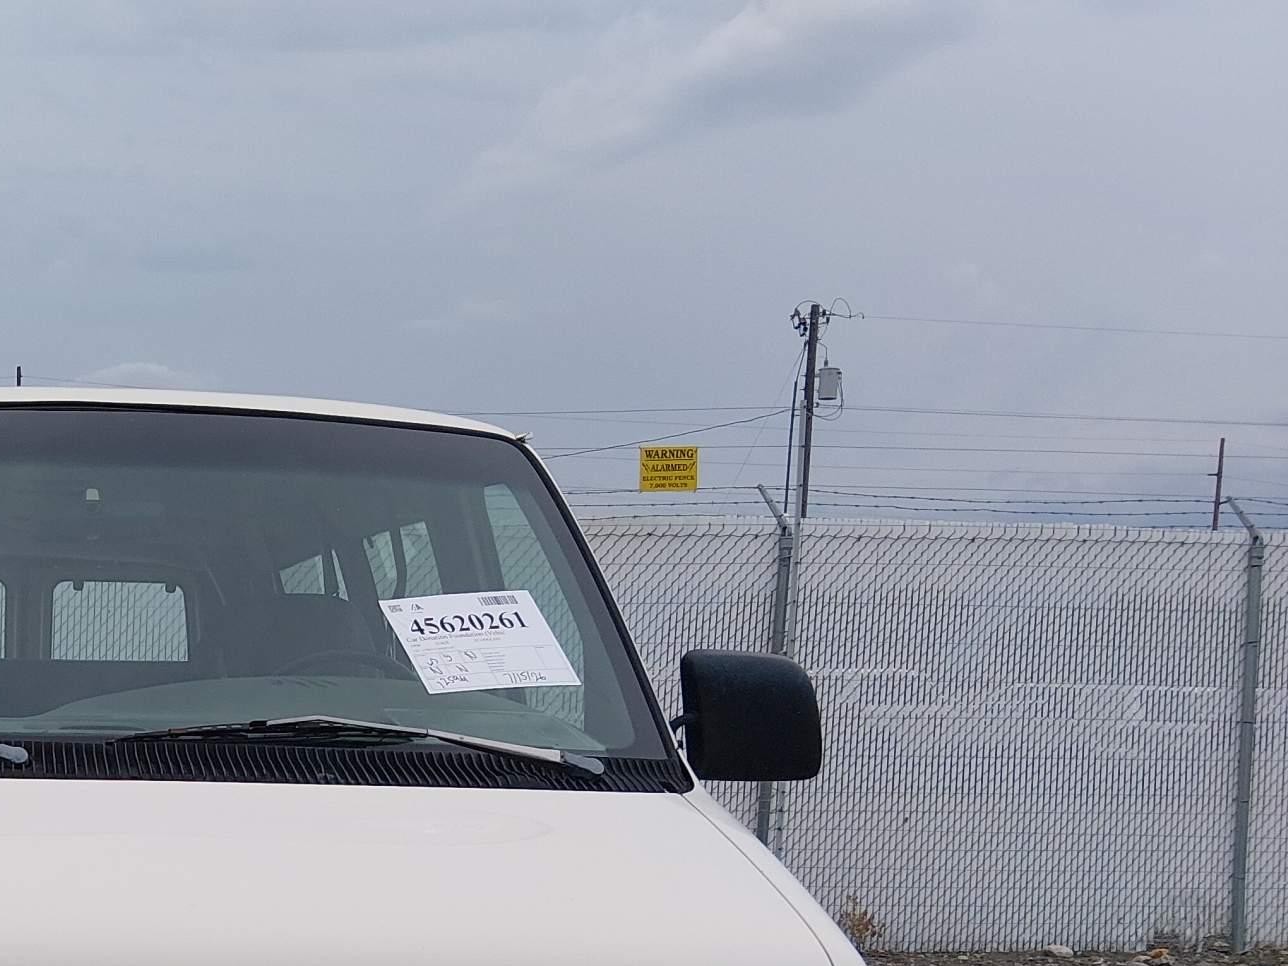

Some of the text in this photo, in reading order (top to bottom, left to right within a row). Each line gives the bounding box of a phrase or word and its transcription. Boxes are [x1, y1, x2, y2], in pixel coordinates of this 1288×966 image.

[644, 449, 694, 459] WARNING
[650, 463, 688, 472] ALARMED
[410, 611, 529, 635] 45620261
